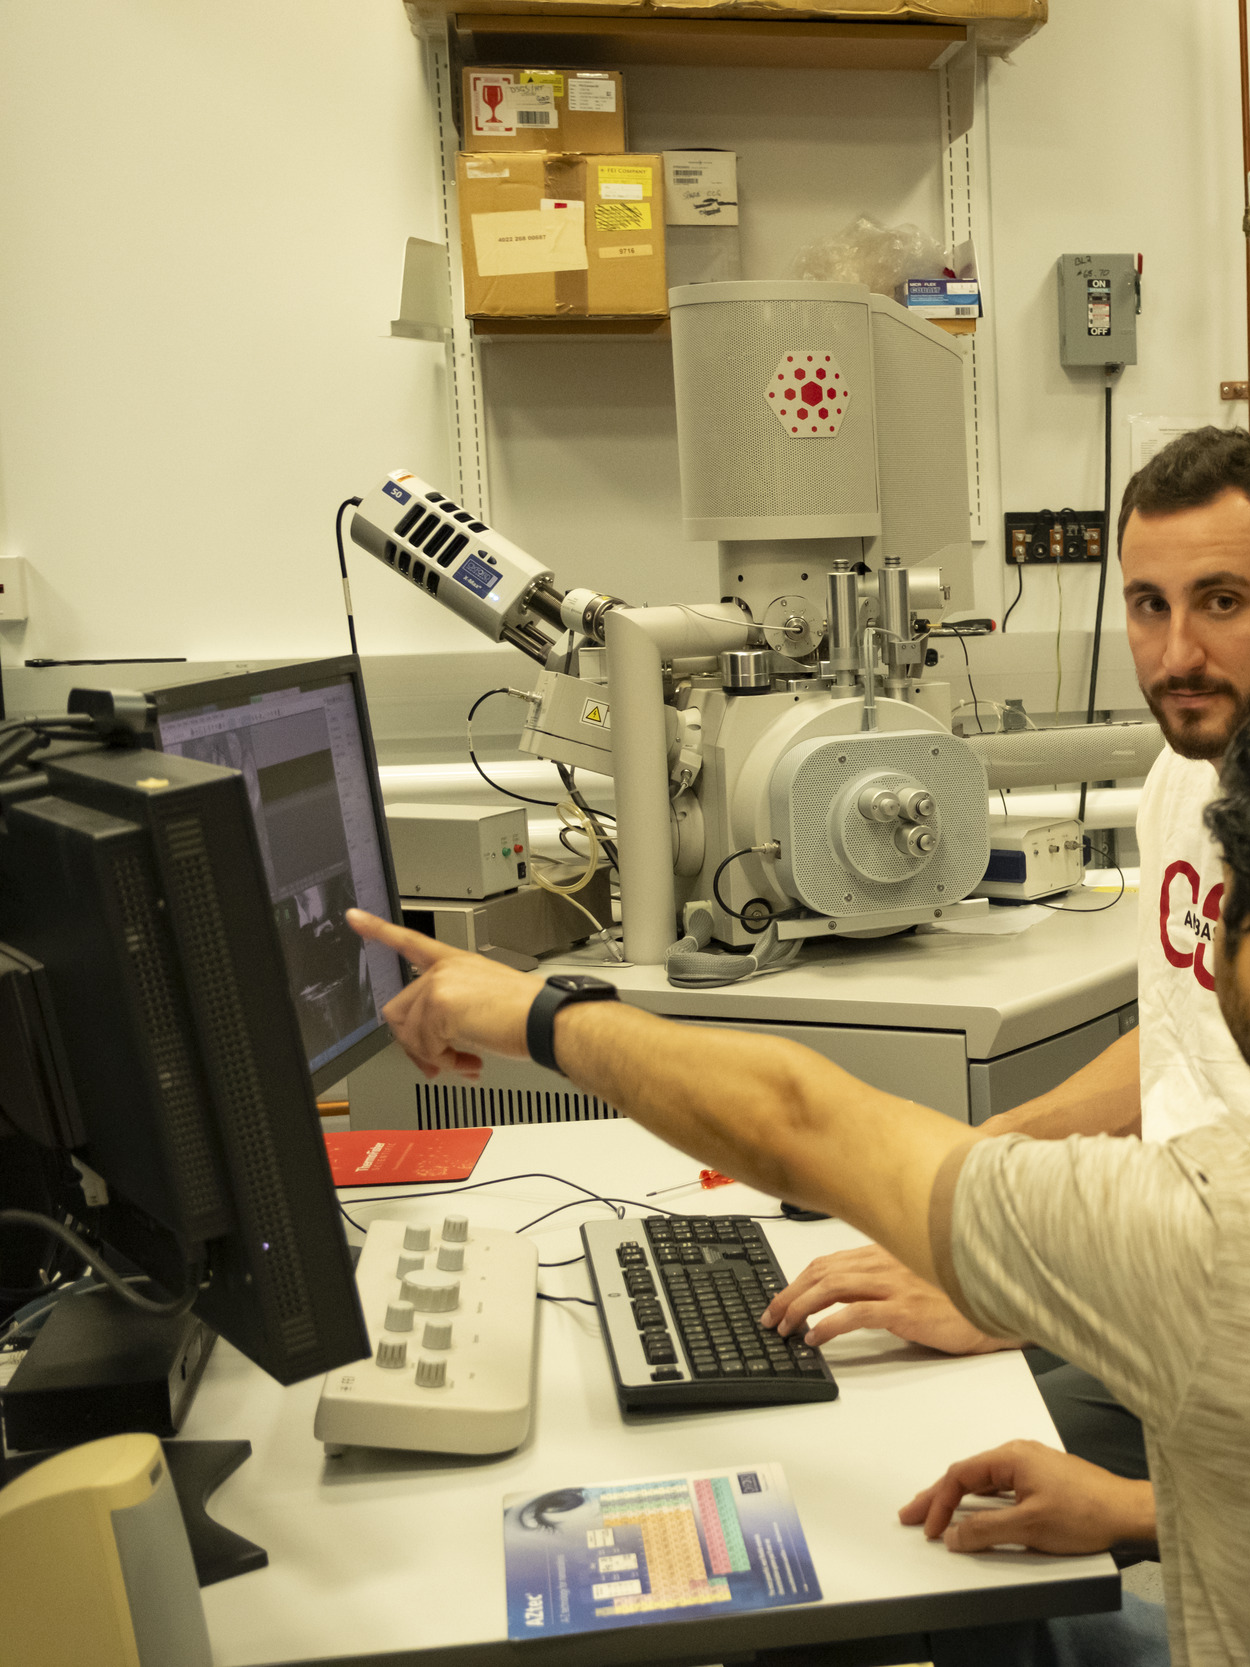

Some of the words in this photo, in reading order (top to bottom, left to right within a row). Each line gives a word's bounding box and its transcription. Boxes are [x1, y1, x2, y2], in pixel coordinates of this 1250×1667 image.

[618, 247, 635, 255] 9716
[1092, 280, 1106, 288] ON
[1090, 327, 1108, 336] OFF
[390, 487, 403, 499] 50
